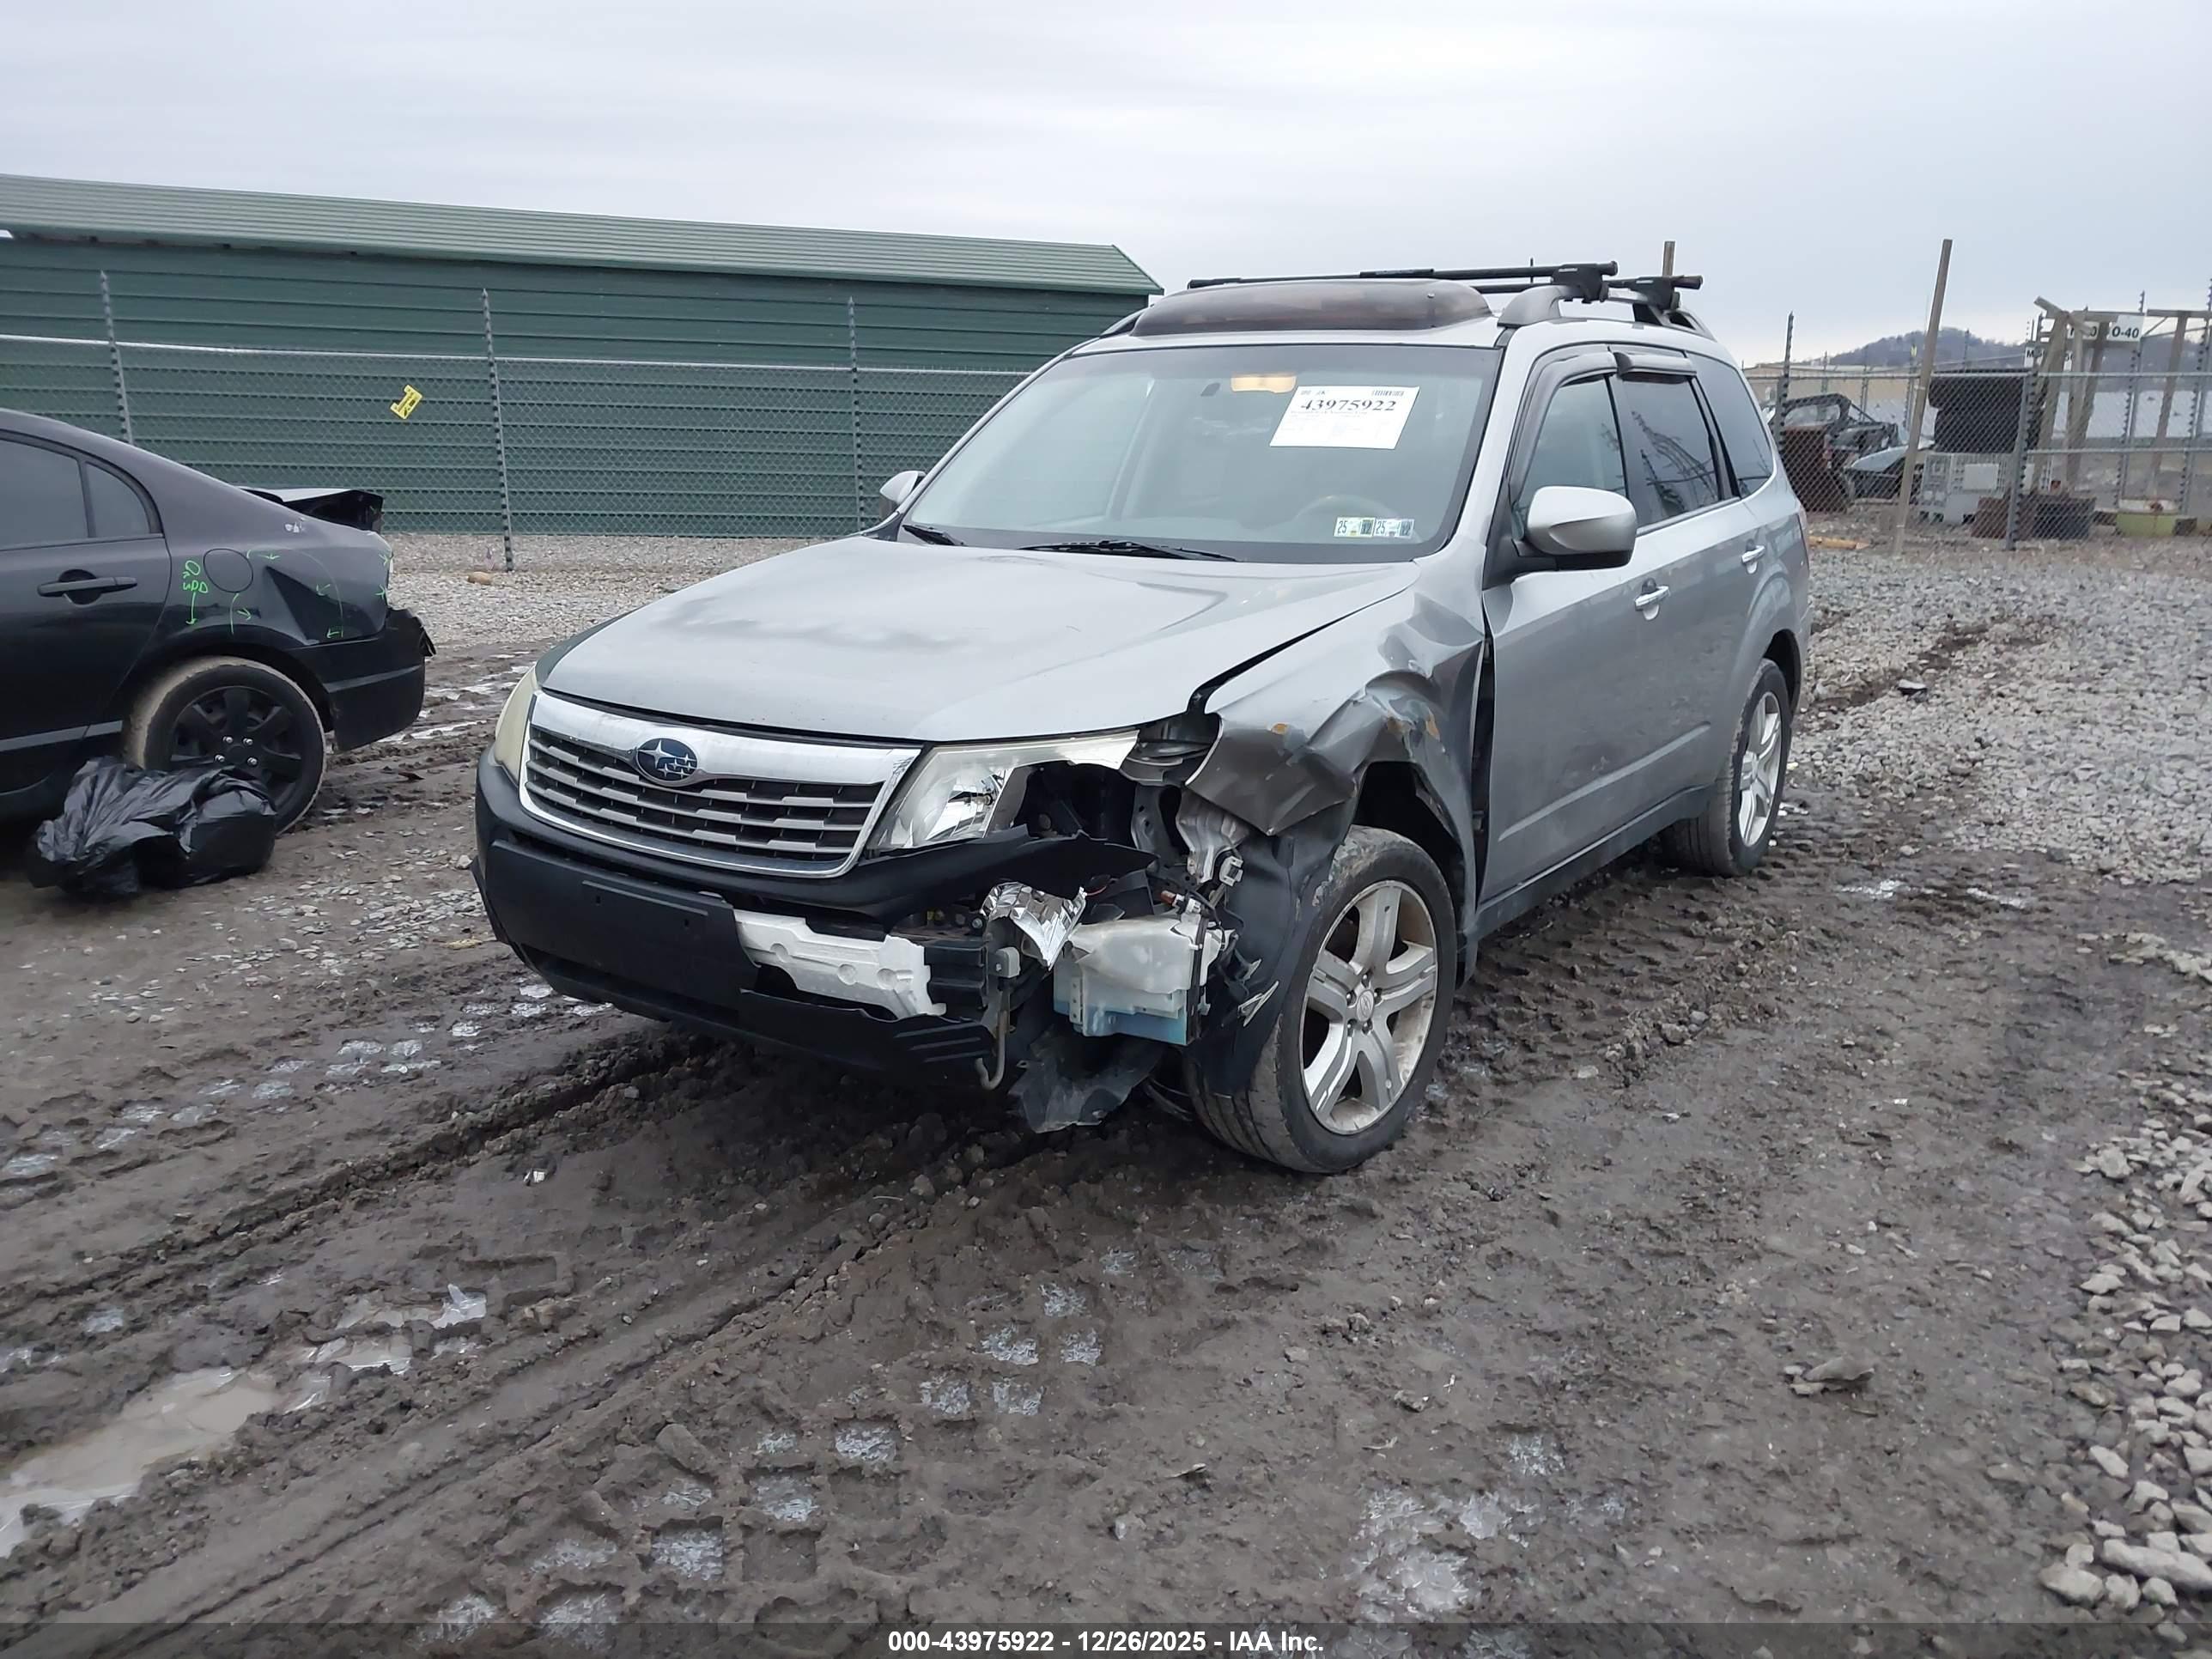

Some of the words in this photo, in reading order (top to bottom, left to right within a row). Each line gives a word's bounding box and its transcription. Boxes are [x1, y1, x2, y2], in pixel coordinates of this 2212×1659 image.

[2112, 325, 2140, 338] O-40
[1300, 399, 1397, 411] 43975922
[1337, 520, 1348, 534] 25
[1376, 520, 1387, 534] 25
